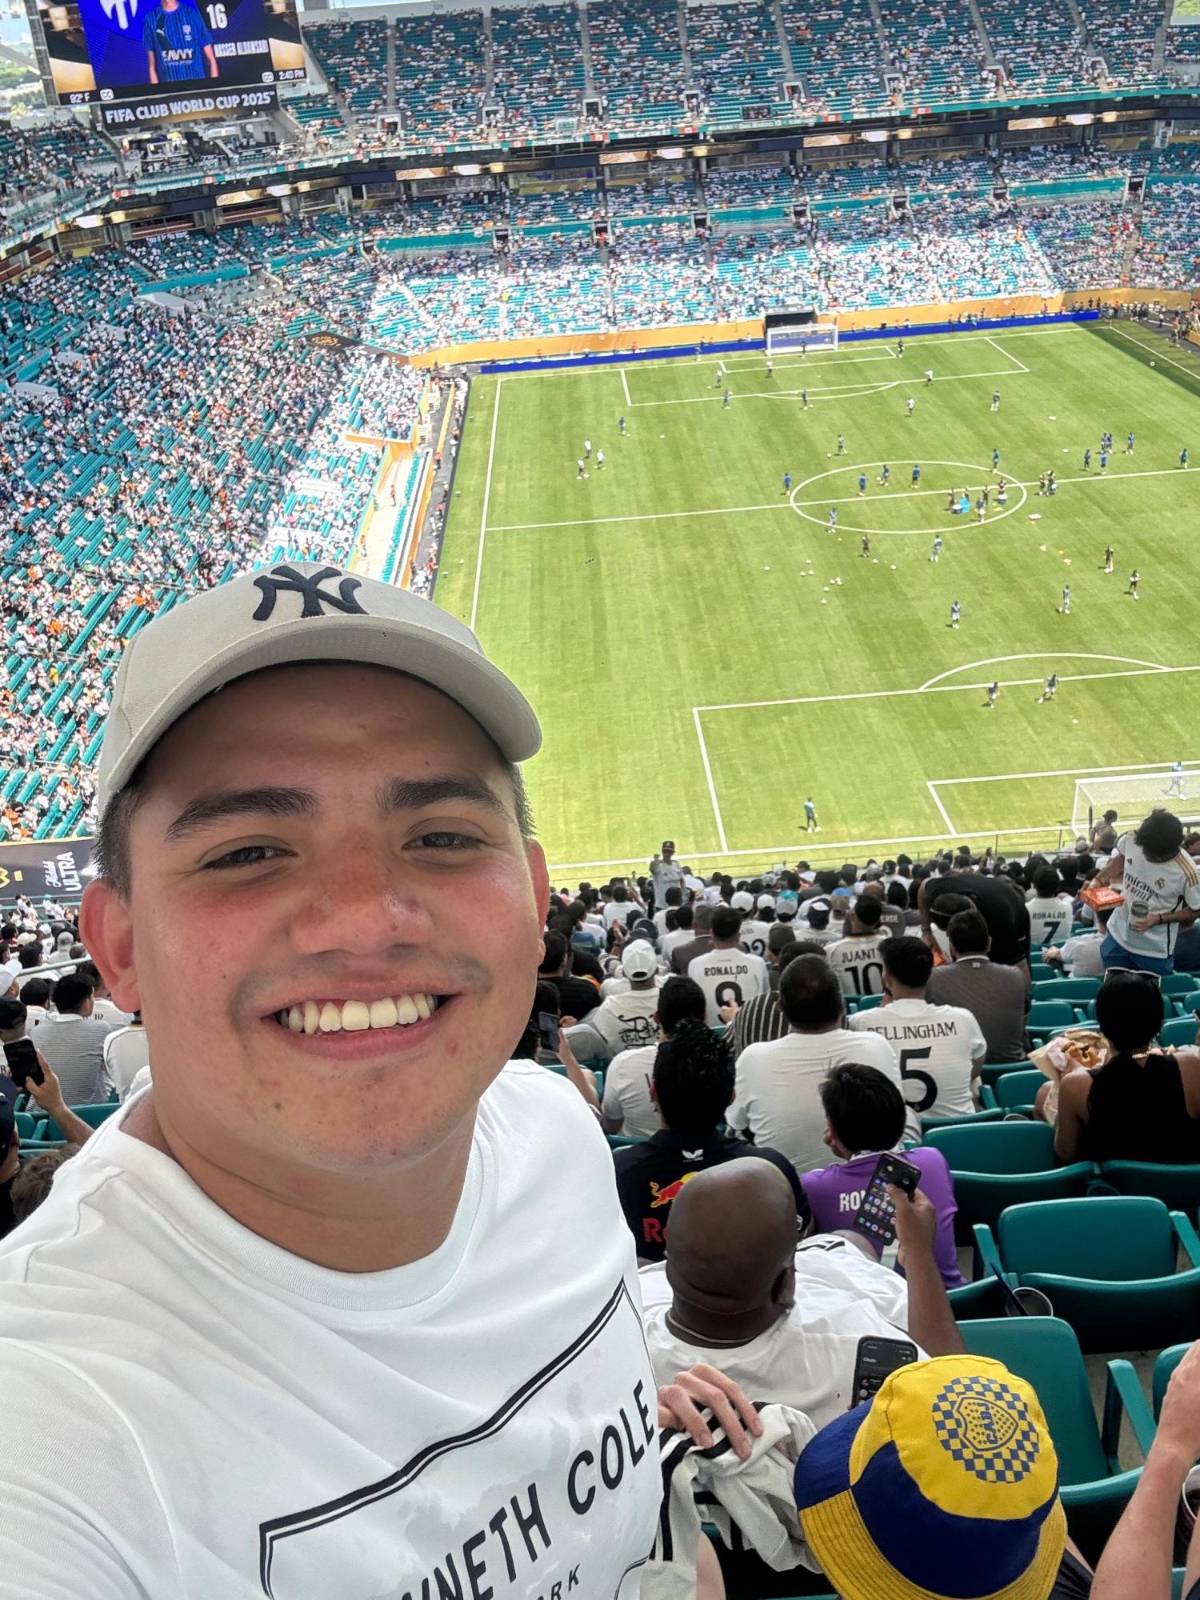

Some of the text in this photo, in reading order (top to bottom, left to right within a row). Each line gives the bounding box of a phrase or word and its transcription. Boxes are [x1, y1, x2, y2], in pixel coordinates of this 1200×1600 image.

[206, 4, 228, 29] 16
[105, 108, 135, 123] FIFA
[136, 103, 169, 120] CLUB
[169, 98, 214, 116] WORLD
[216, 96, 240, 110] CUP
[57, 851, 82, 891] ULTRA
[1043, 921, 1061, 944] 7
[704, 965, 748, 977] RONALDO
[844, 962, 883, 995] 10
[900, 1046, 938, 1113] 5
[567, 1380, 655, 1514] COLE
